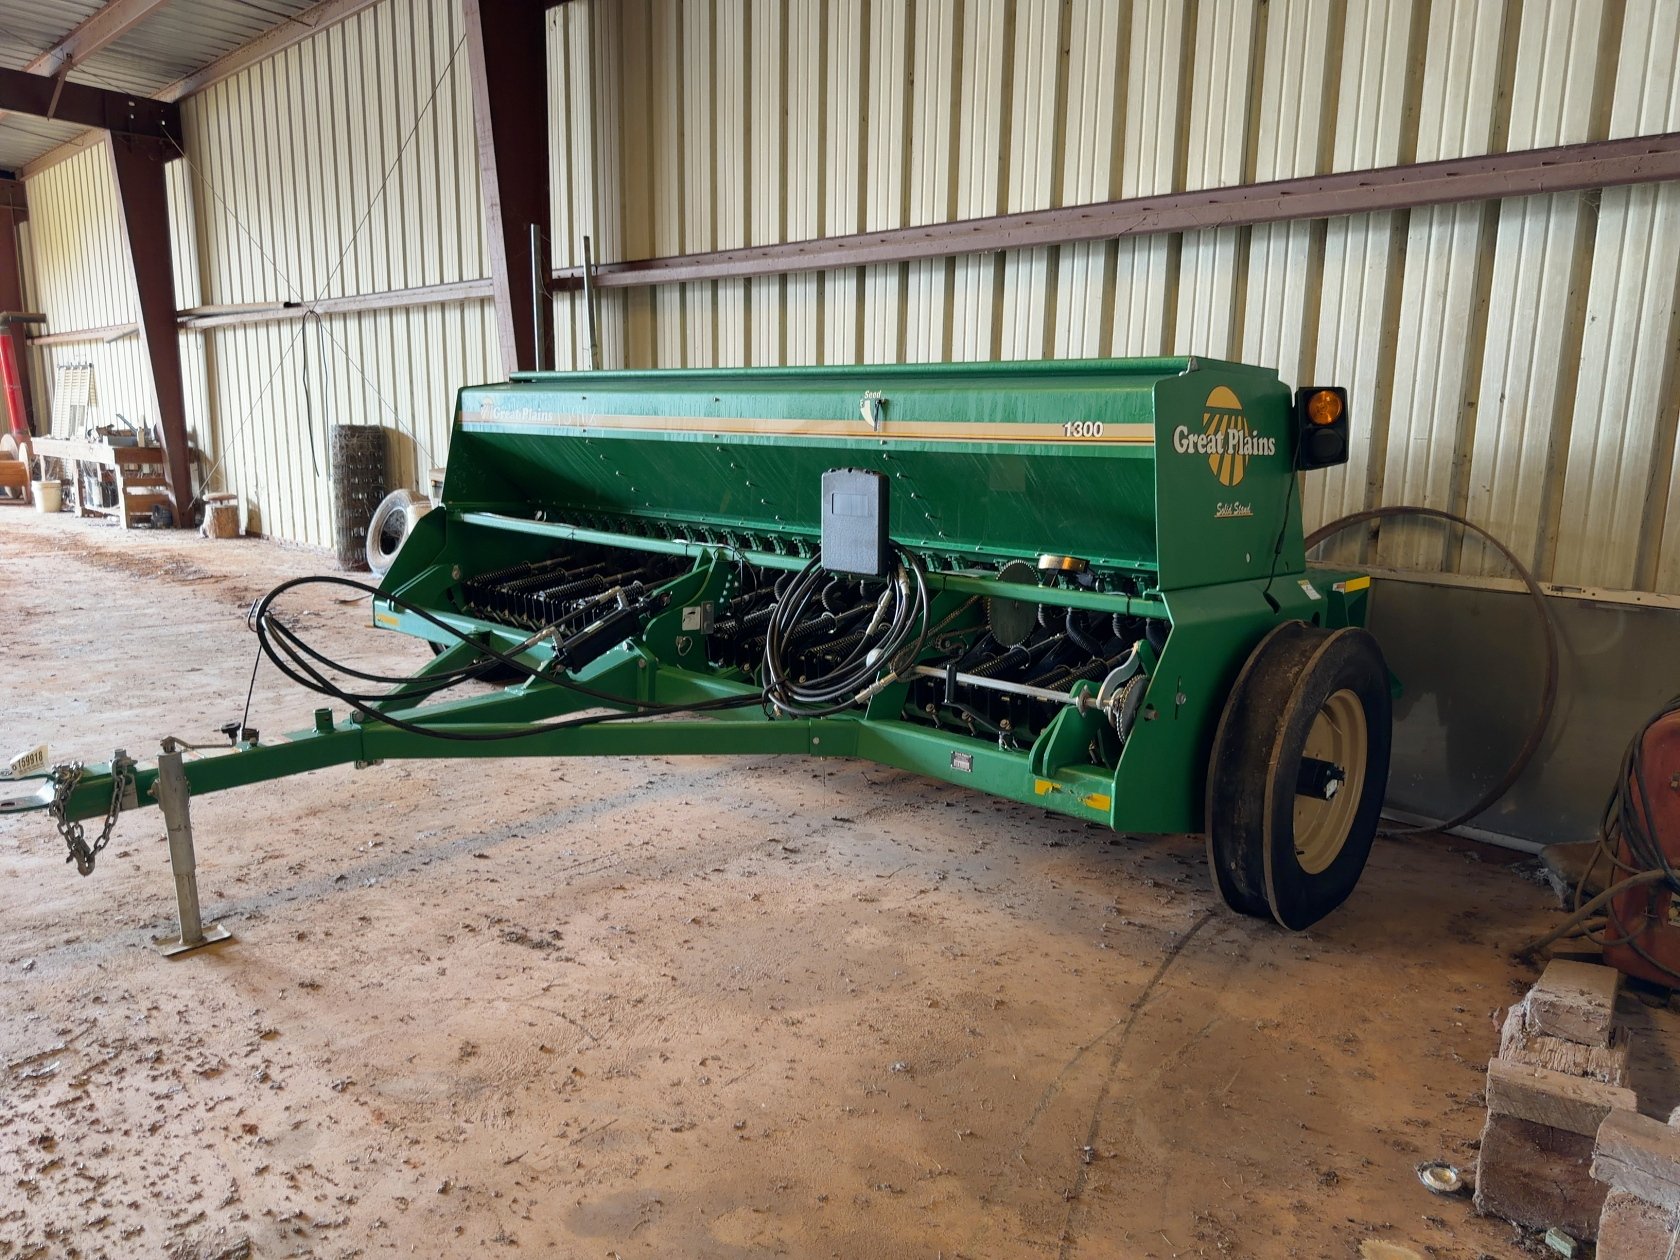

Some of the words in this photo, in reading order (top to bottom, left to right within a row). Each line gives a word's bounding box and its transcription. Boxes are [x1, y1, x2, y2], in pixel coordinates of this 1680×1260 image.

[864, 390, 881, 399] Seed
[493, 406, 521, 420] Great
[522, 407, 553, 421] Plains
[1062, 421, 1104, 438] 1300
[1173, 425, 1224, 454] Great
[1227, 428, 1276, 456] Plains
[1216, 502, 1233, 515] Solid
[17, 751, 43, 770] 159918
